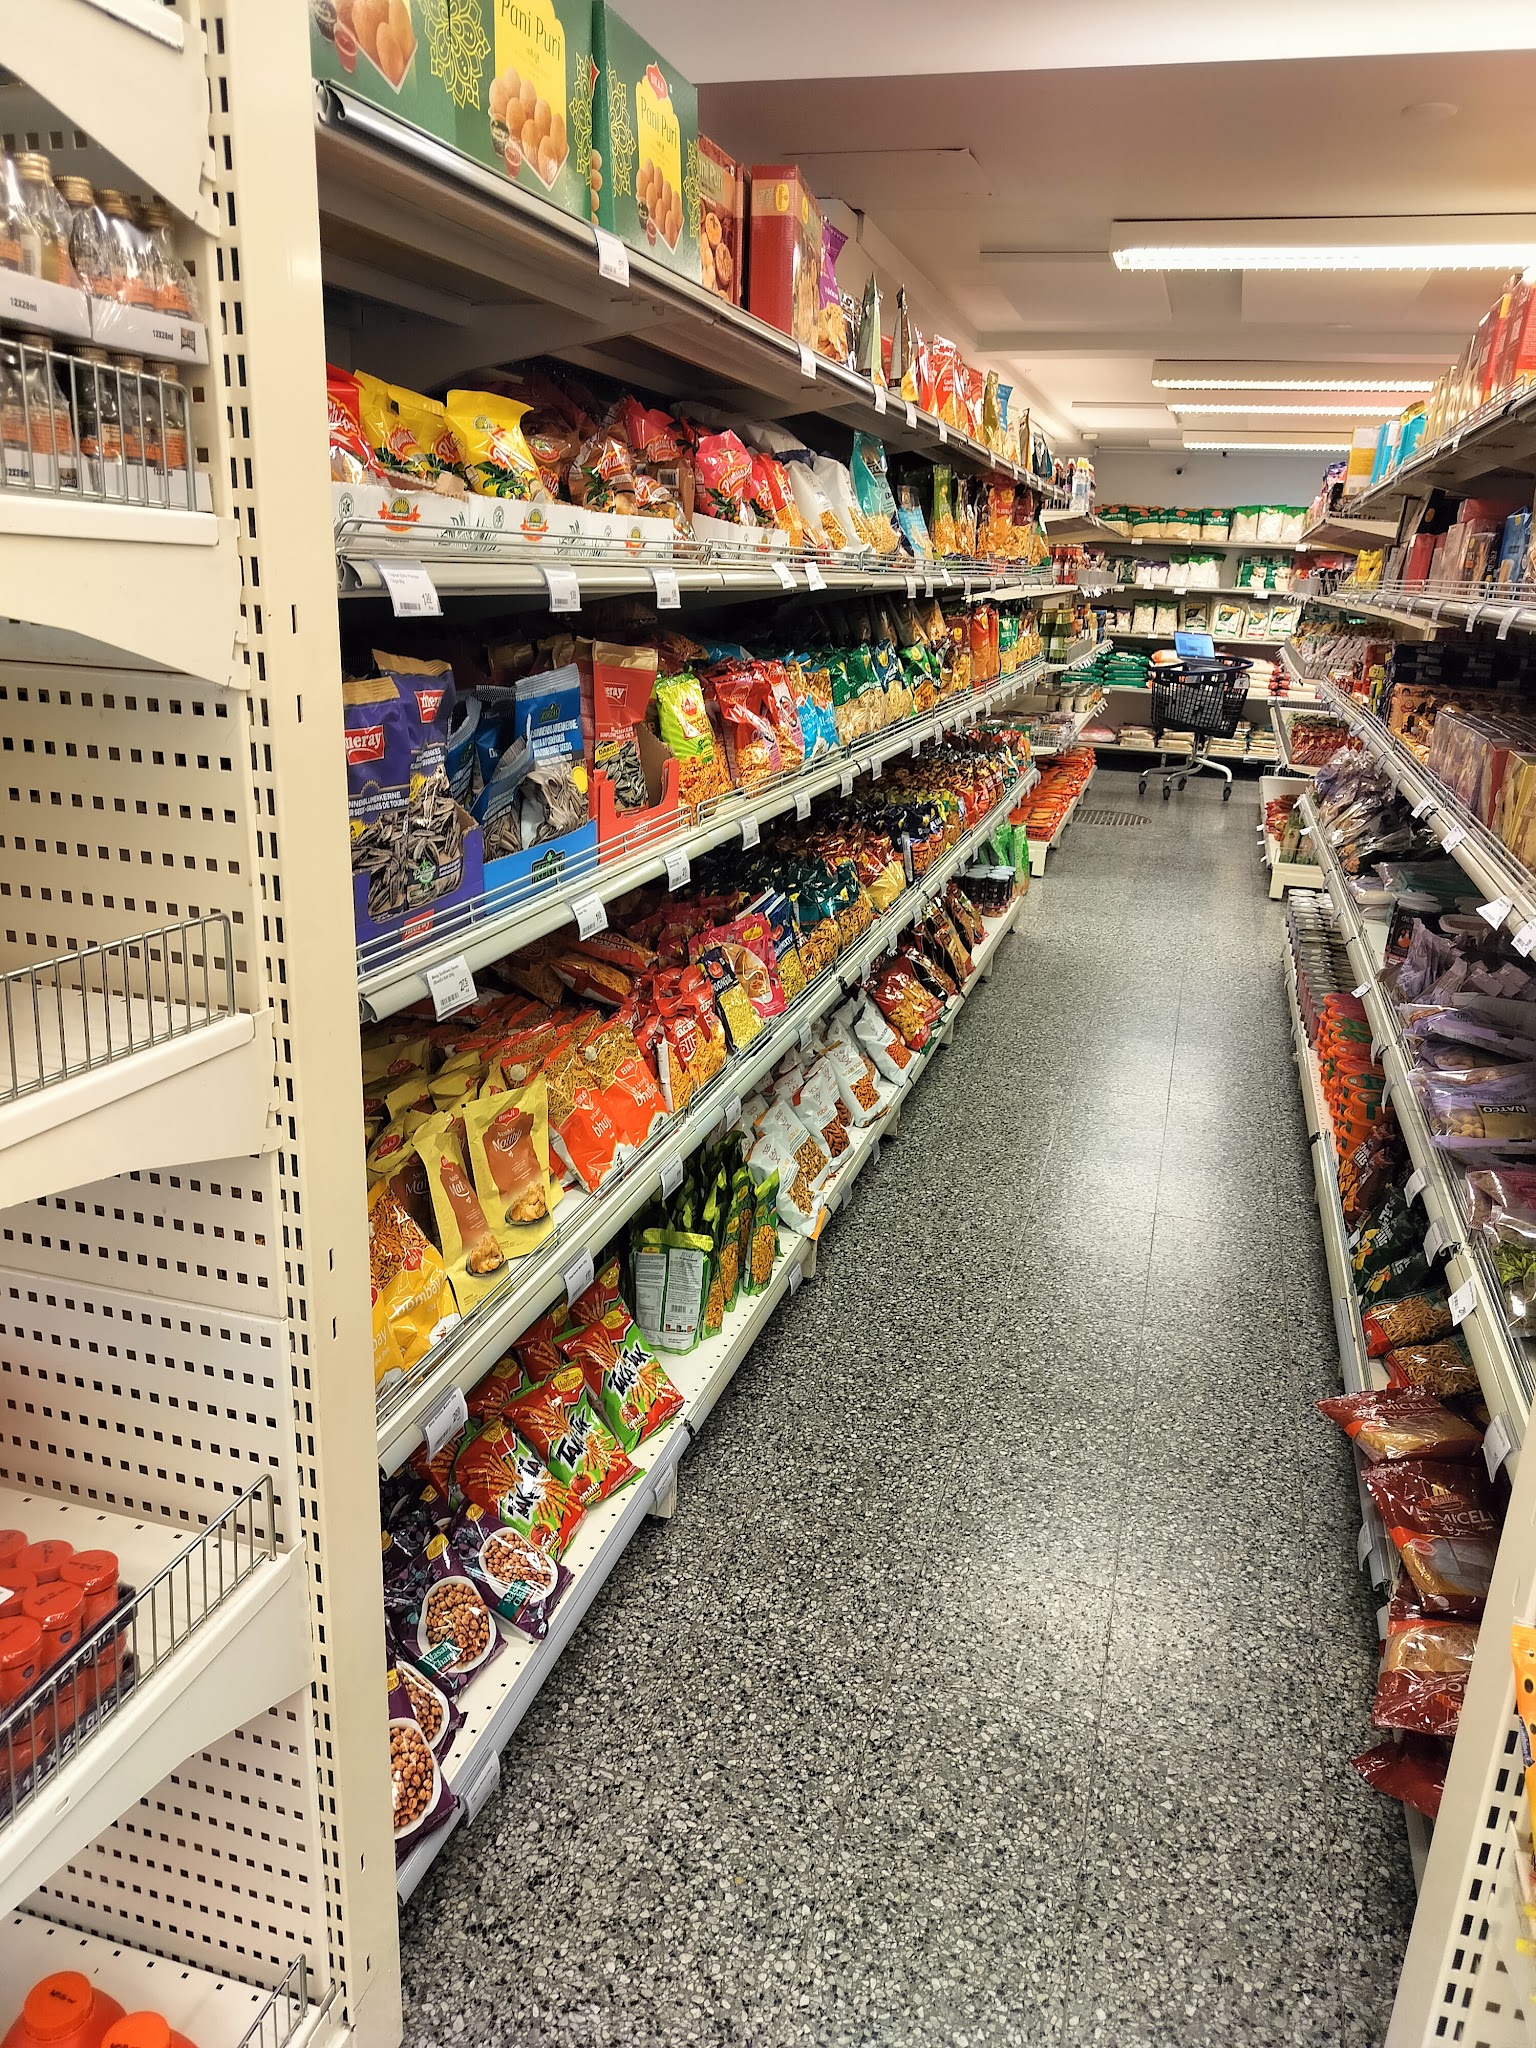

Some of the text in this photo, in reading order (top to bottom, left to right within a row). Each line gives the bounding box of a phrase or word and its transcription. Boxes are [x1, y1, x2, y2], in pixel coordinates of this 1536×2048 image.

[500, 0, 531, 38] Pani
[535, 14, 562, 61] Puri
[640, 95, 678, 149] Pani Puri
[1482, 1104, 1527, 1114] NATCO
[607, 1342, 653, 1397] TAKA-TAK
